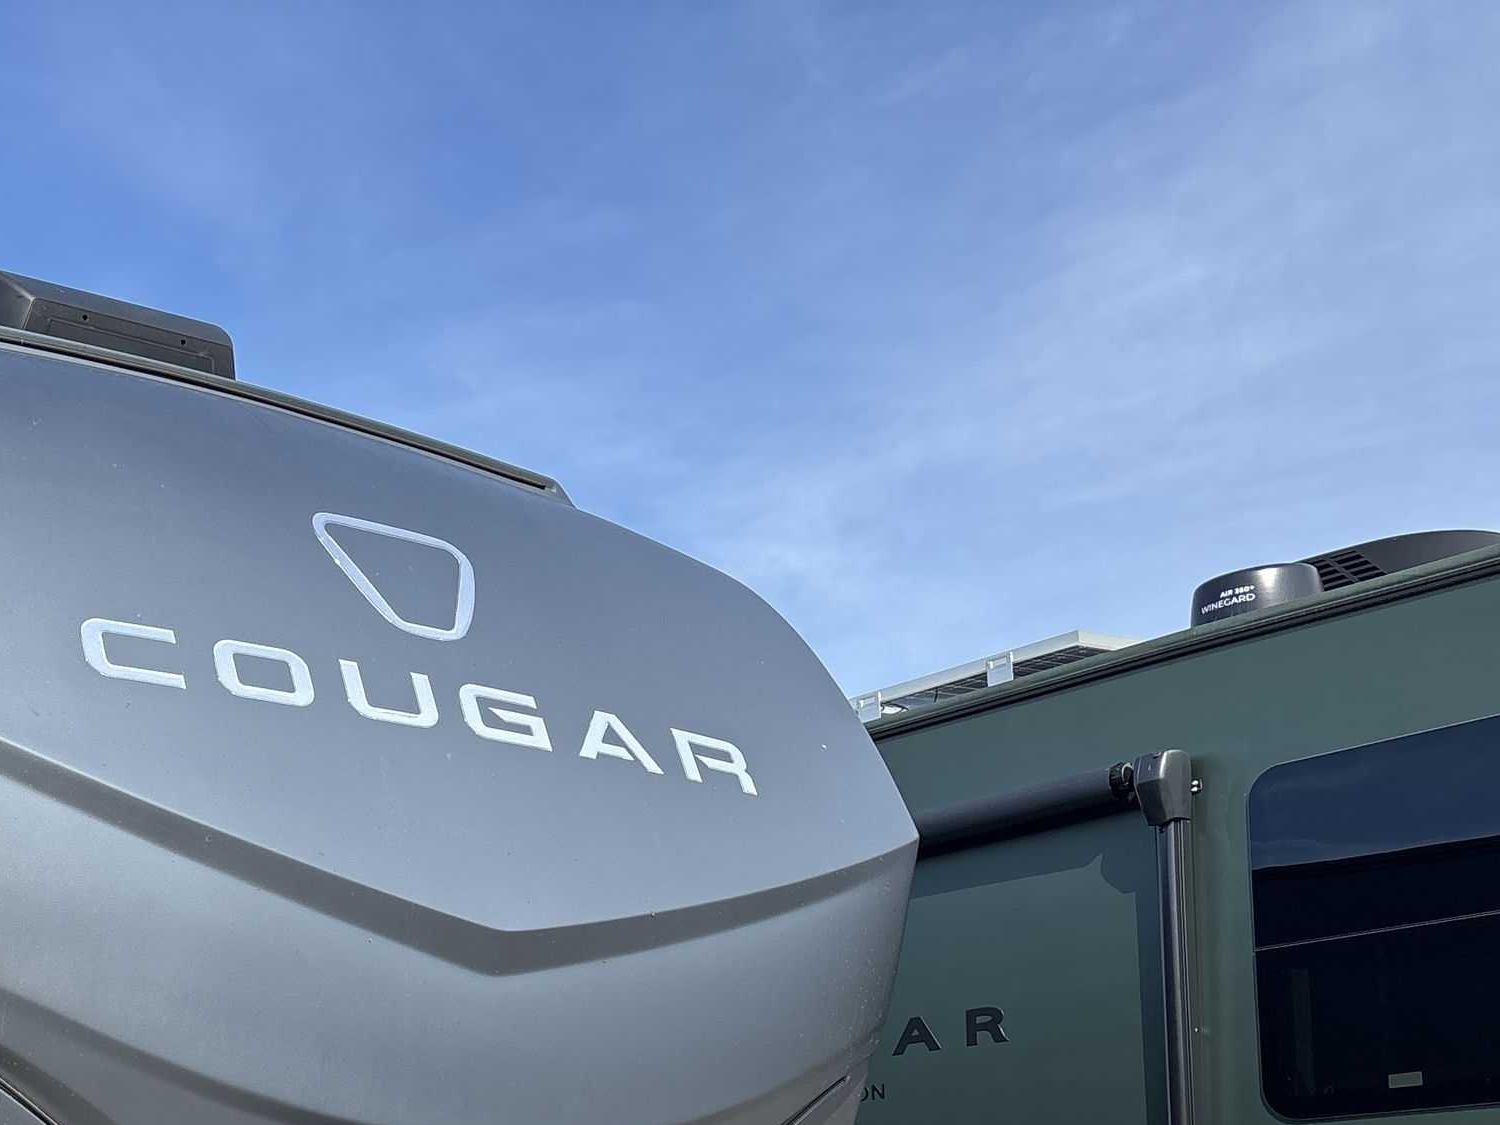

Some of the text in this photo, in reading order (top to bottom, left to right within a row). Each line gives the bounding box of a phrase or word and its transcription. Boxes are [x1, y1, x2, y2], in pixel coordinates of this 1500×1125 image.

[1201, 593, 1256, 614] WINEGARD
[1220, 589, 1233, 598] AIR
[80, 617, 758, 796] COUGAR
[892, 1007, 1010, 1056] AR
